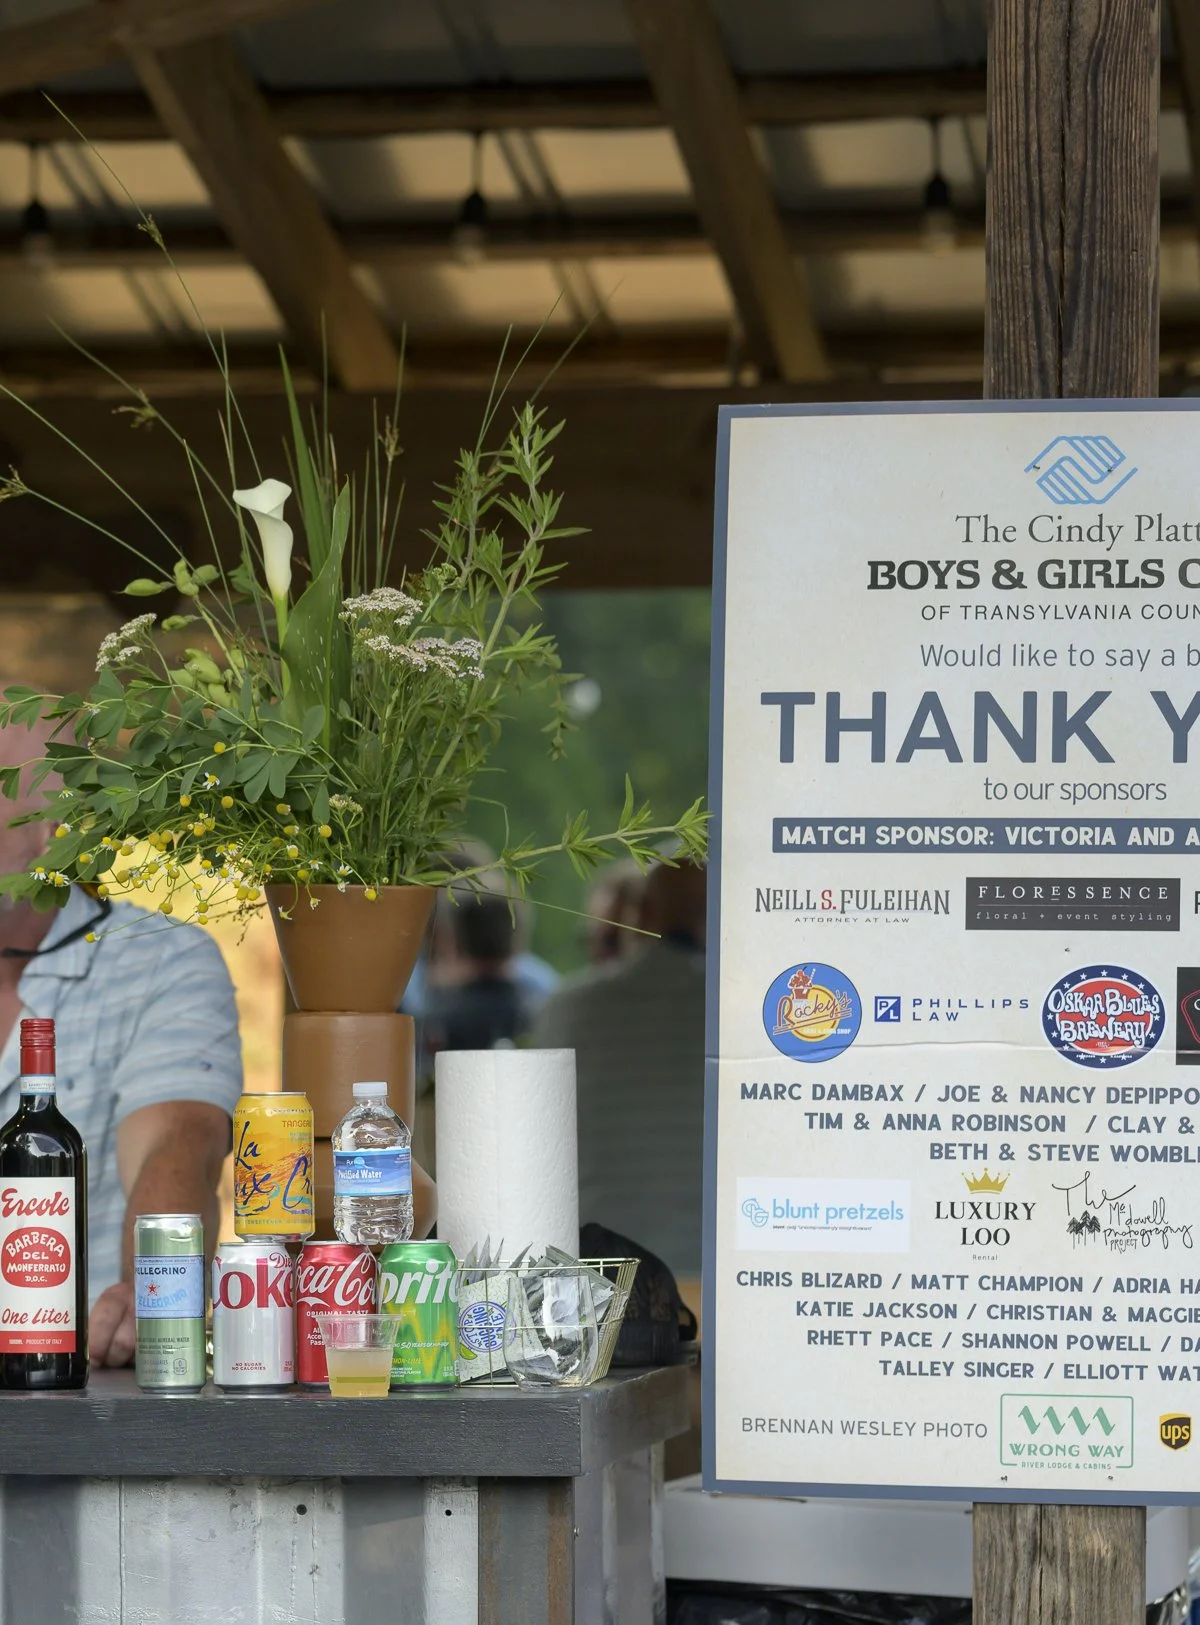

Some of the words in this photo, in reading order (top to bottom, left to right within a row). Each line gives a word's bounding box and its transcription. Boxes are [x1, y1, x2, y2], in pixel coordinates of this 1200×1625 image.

[955, 514, 1016, 542] The
[1029, 513, 1124, 551] Cindy
[867, 560, 980, 590] BOYS
[992, 560, 1027, 590] &
[1038, 559, 1164, 589] GIRLS
[922, 605, 950, 620] OF
[960, 605, 1131, 620] TRANSYLVANIA
[921, 644, 1000, 666] Would
[1013, 644, 1057, 666] like
[1068, 644, 1094, 666] to
[1106, 649, 1150, 672] say
[1162, 649, 1174, 666] a
[761, 691, 1115, 763] THANK
[984, 777, 1007, 800] to
[1014, 783, 1054, 800] our
[1060, 783, 1166, 805] sponsors
[783, 826, 865, 845] MATCH
[876, 826, 994, 845] SPONSOR:
[1005, 826, 1116, 845] VICTORIA
[1127, 827, 1174, 845] AND
[756, 888, 816, 912] NEILL
[821, 890, 836, 910] S.
[840, 890, 949, 914] FULEIHAN
[979, 886, 1167, 900] FLORESSENCE
[976, 911, 1027, 920] floral
[1111, 912, 1172, 922] styling
[777, 989, 853, 1027] Rocky's
[913, 999, 1028, 1008] PHILLIPS
[913, 1012, 958, 1021] LAW
[741, 1083, 801, 1100] MARC
[812, 1084, 903, 1101] DAMBAX
[915, 1084, 926, 1102] /
[937, 1085, 980, 1102] JOE
[992, 1085, 1008, 1103] &
[1020, 1086, 1096, 1103] NANCY
[804, 1113, 842, 1129] TIM
[854, 1113, 870, 1130] &
[883, 1114, 941, 1130] ANNA
[952, 1114, 1065, 1132] ROBINSON
[1085, 1115, 1097, 1133] /
[1108, 1116, 1166, 1133] CLAY
[1178, 1117, 1194, 1134] &
[930, 1143, 987, 1160] BETH
[999, 1143, 1015, 1161] &
[1028, 1144, 1099, 1161] STEVE
[360, 1169, 383, 1179] Water
[1, 1187, 70, 1218] Ercole
[1052, 1171, 1136, 1216] The
[773, 1199, 819, 1218] blunt
[826, 1200, 904, 1224] pretzels
[936, 1202, 1036, 1220] LUXURY
[5, 1231, 65, 1258] BARBERA
[962, 1228, 1010, 1245] LOO
[22, 1251, 49, 1260] DEL
[6, 1263, 66, 1273] MONFERRATO
[24, 1275, 48, 1283] D.O.C.
[737, 1271, 792, 1287] CHRIS
[802, 1272, 882, 1288] BLIZARD
[892, 1273, 902, 1289] /
[912, 1274, 969, 1290] MATT
[978, 1275, 1083, 1292] CHAMPION
[1093, 1277, 1103, 1293] /
[1113, 1278, 1171, 1293] ADRIA
[1, 1308, 29, 1325] One
[31, 1308, 71, 1325] Liter
[797, 1301, 853, 1317] KATIE
[863, 1303, 957, 1319] JACKSON
[967, 1304, 977, 1320] /
[987, 1304, 1092, 1321] CHRISTIAN
[1102, 1306, 1117, 1322] &
[808, 1330, 872, 1346] RHETT
[881, 1331, 932, 1347] PACE
[942, 1332, 952, 1348] /
[962, 1333, 1057, 1349] SHANNON
[1067, 1335, 1151, 1351] POWELL
[1161, 1336, 1171, 1352] /
[879, 1360, 954, 1376] TALLEY
[964, 1362, 1034, 1378] SINGER
[1044, 1363, 1054, 1379] /
[1064, 1364, 1148, 1380] ELLIOTT
[742, 1418, 832, 1434] BRENNAN
[841, 1420, 916, 1436] WESLEY
[924, 1423, 987, 1438] PHOTO
[1161, 1425, 1190, 1445] ups
[1009, 1444, 1079, 1457] WRONG
[1088, 1445, 1124, 1457] WAY
[1021, 1461, 1045, 1469] RIVER
[1047, 1462, 1073, 1470] LODGE
[1082, 1462, 1112, 1470] CABINS
